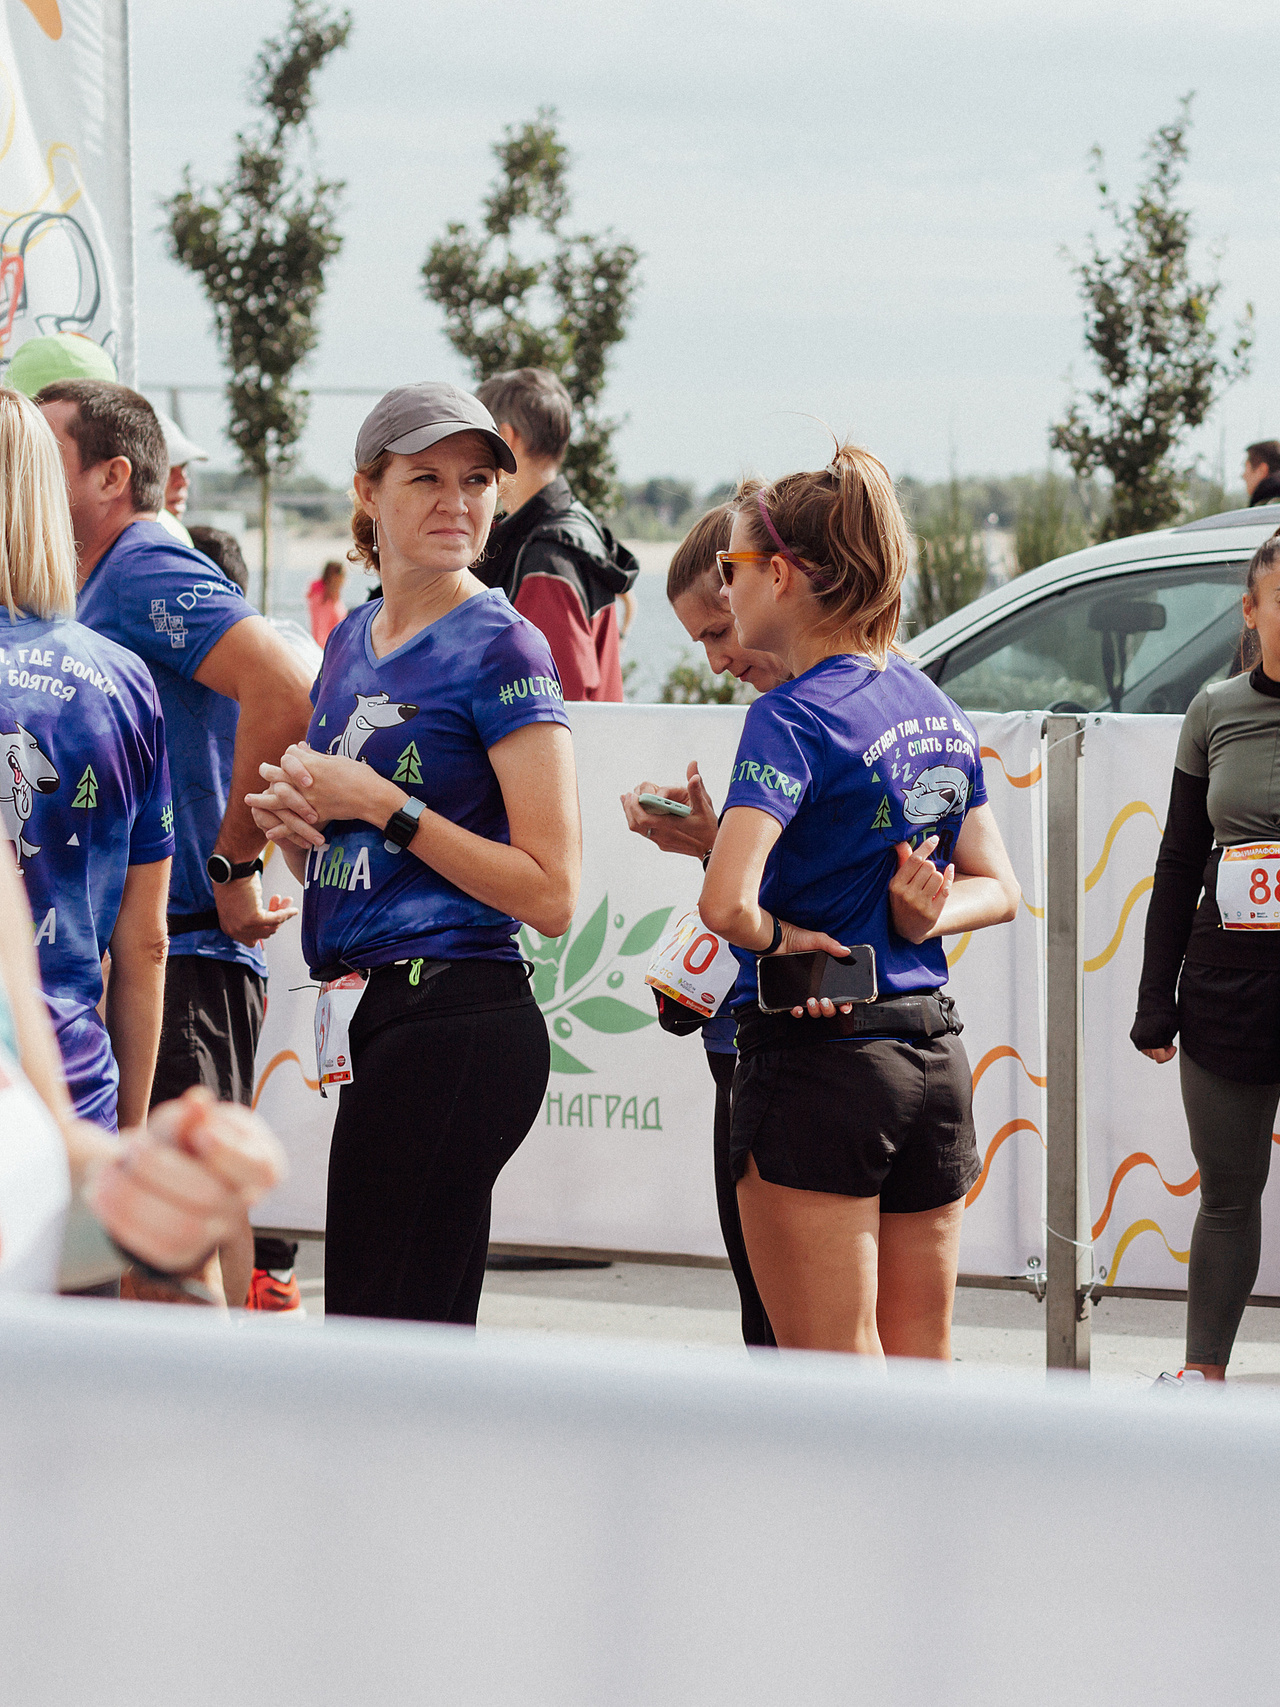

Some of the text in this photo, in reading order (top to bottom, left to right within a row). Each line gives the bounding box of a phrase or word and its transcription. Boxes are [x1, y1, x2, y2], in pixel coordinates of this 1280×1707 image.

[8, 669, 77, 702] БОЯТСЯ
[18, 647, 55, 667] ГДЕ
[60, 655, 118, 698] ВОЛКИ
[862, 716, 949, 768] БЕГАЕМ ТАМ, ГДЕ
[907, 737, 943, 757] СПАТЬ
[546, 1091, 663, 1131] НАГРАД
